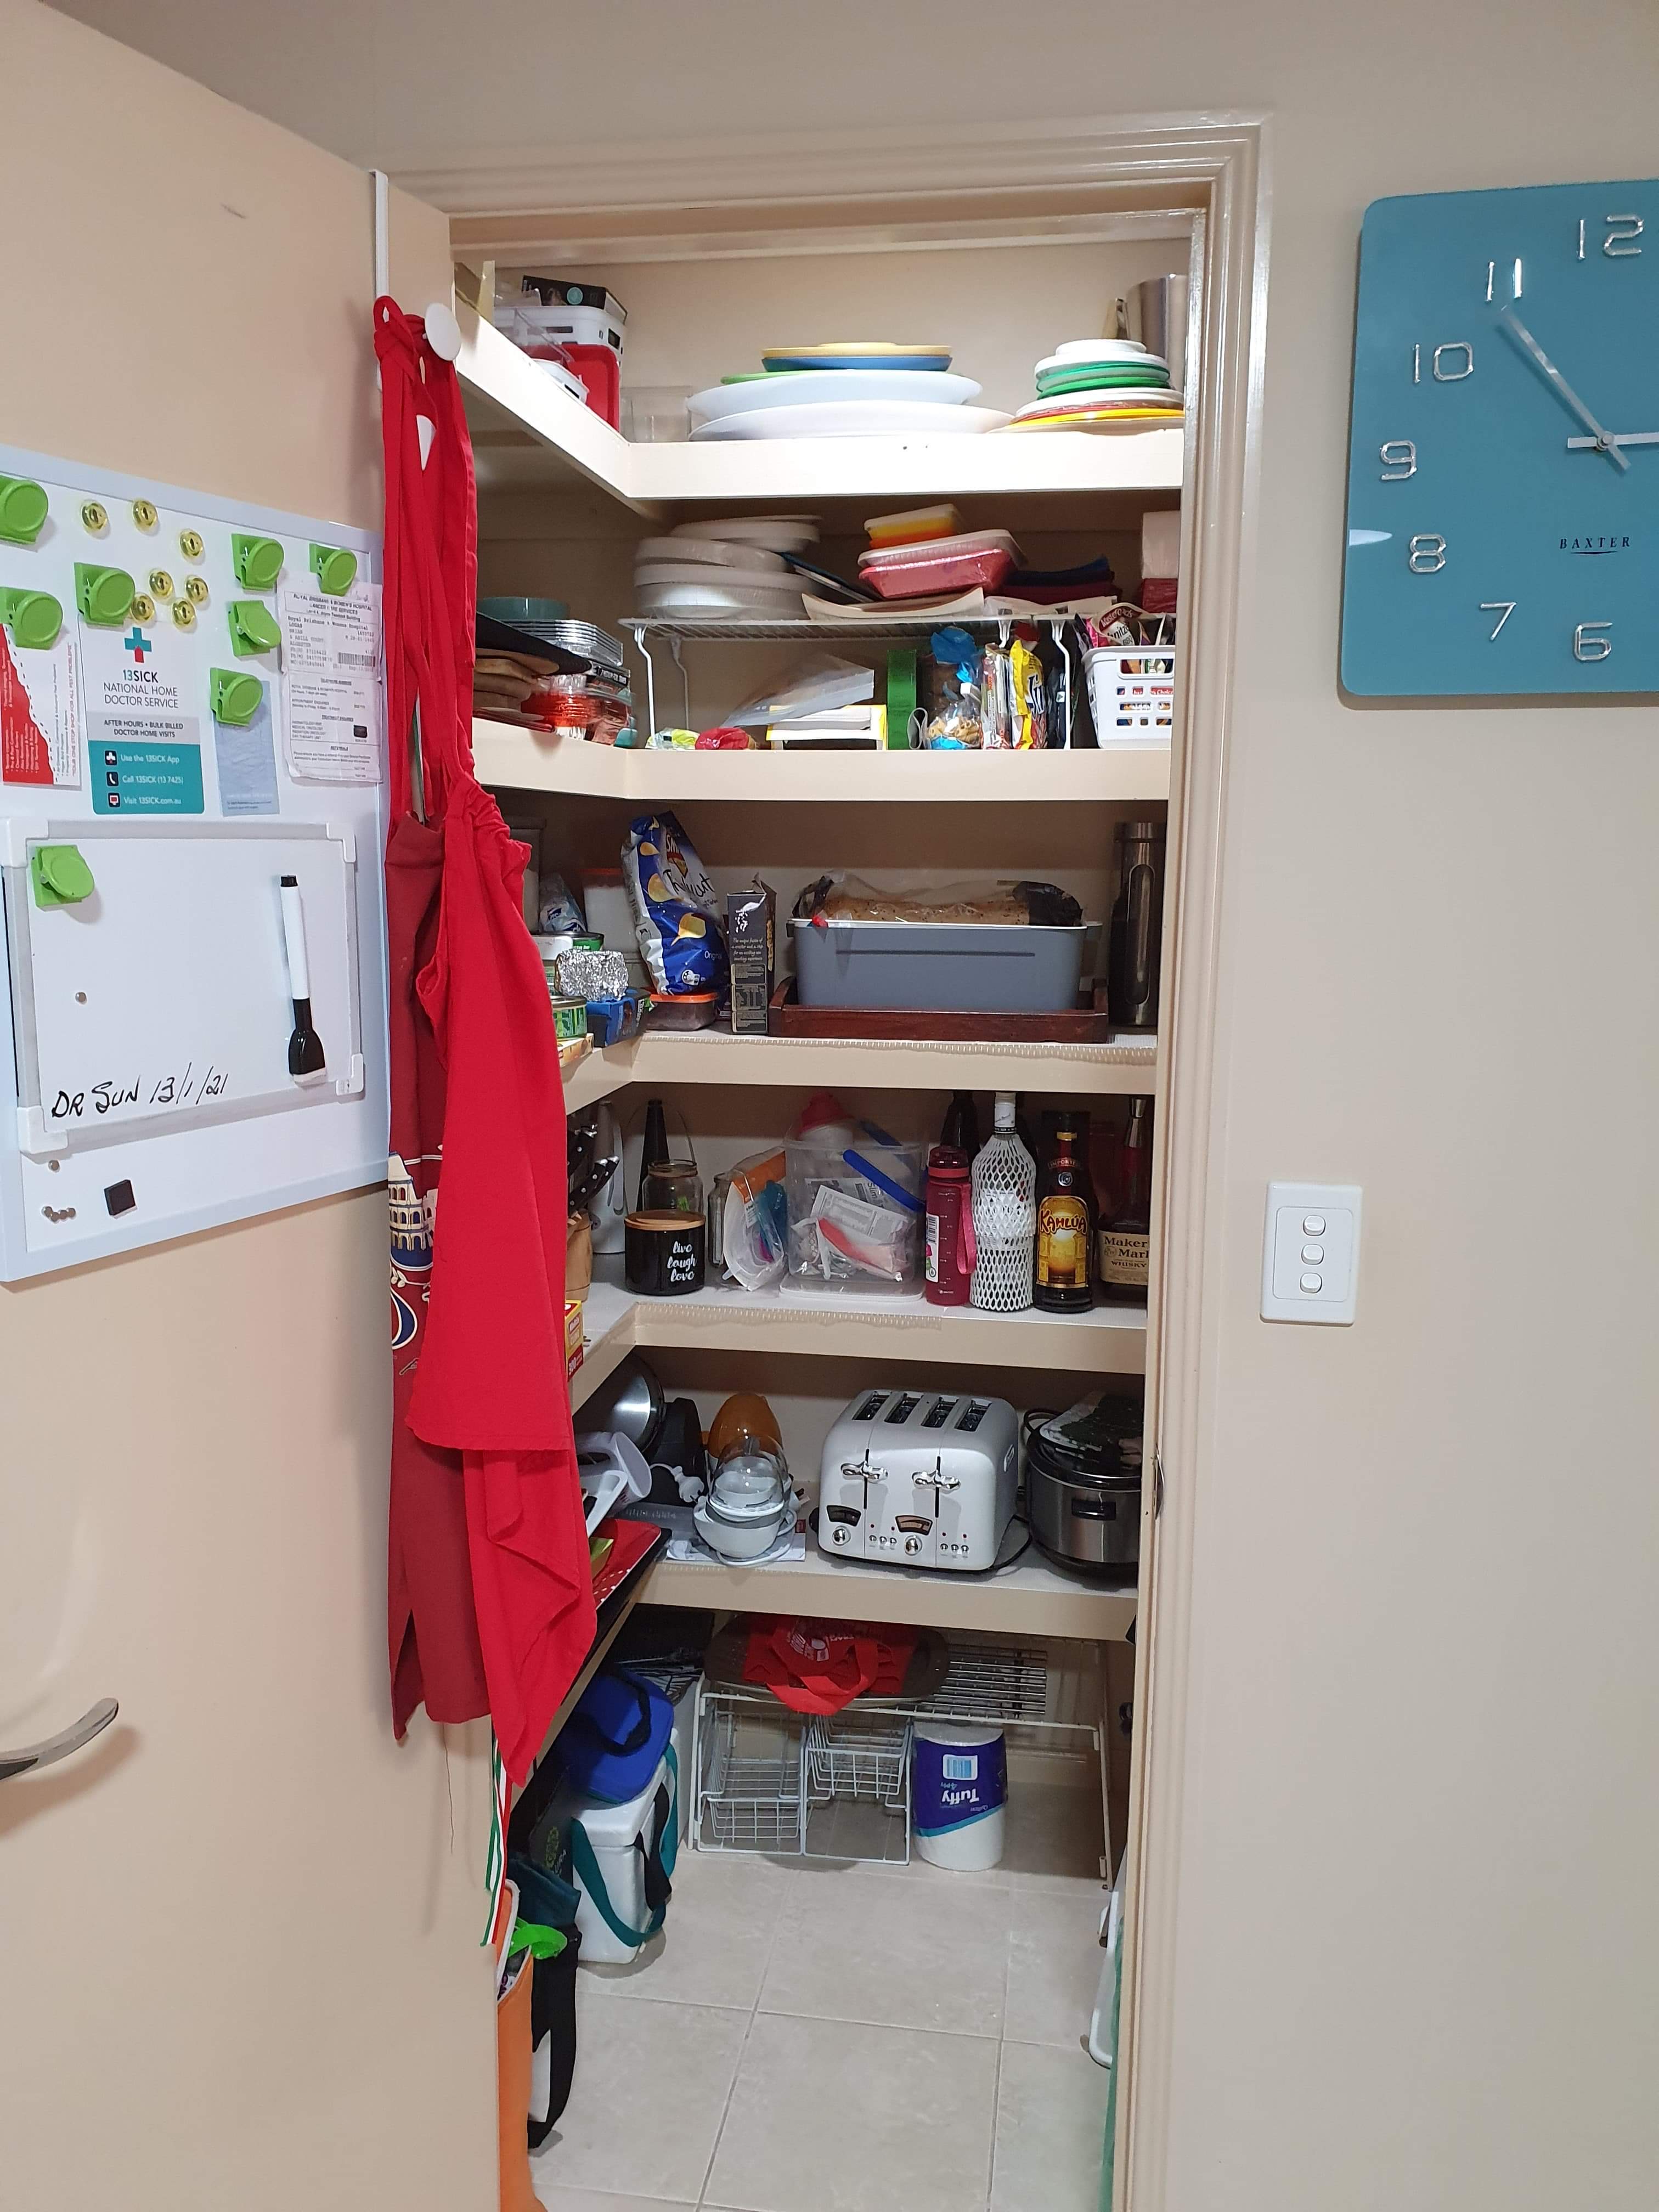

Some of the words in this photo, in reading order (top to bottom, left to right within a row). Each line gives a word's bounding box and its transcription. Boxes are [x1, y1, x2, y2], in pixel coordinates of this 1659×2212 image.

[1578, 214, 1644, 260] 12
[1485, 257, 1524, 302] 11
[1414, 341, 1474, 384] 10
[1380, 439, 1418, 481] 9
[1409, 533, 1447, 573] 8
[1560, 537, 1629, 549] BAXTER
[1480, 601, 1517, 641] 7
[1573, 621, 1614, 661] 6
[104, 682, 149, 695] NATIONAL
[152, 687, 178, 696] HOME
[123, 669, 159, 683] 13SICK
[105, 695, 142, 706] DOCTOR
[145, 697, 178, 708] SERVICE
[167, 756, 180, 764] App
[122, 775, 134, 783] Call
[52, 1091, 84, 1118] DR
[92, 1075, 140, 1114] SUN
[667, 1254, 697, 1272] laugh
[941, 1788, 979, 1805] Tuffy
